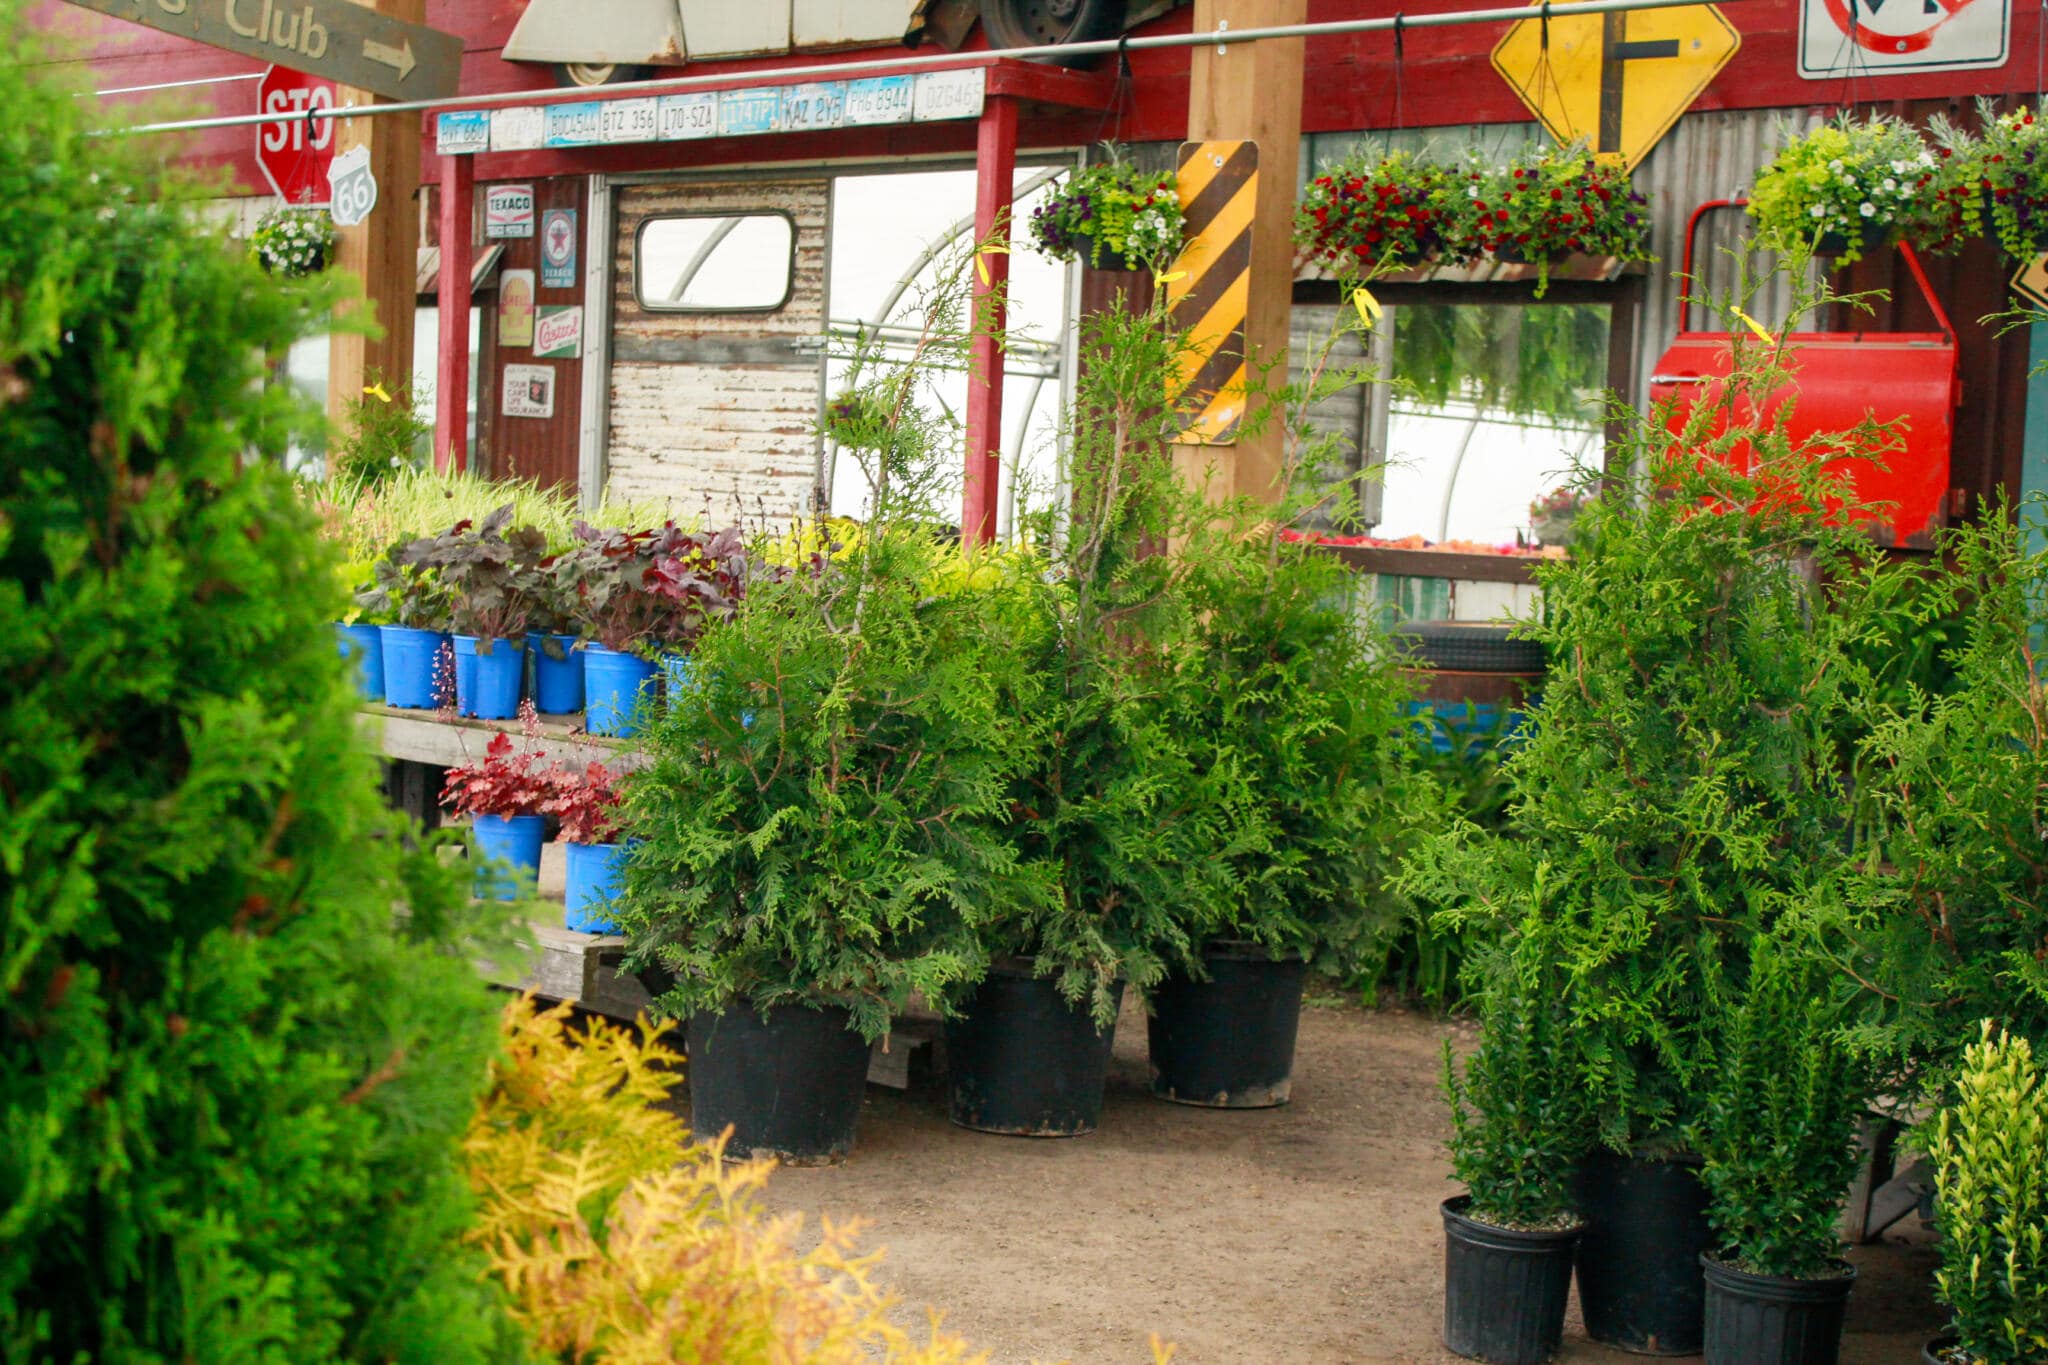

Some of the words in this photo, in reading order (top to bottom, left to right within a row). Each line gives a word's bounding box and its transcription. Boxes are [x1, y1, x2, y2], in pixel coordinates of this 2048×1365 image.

[225, 0, 329, 59] Club
[264, 86, 334, 152] STO
[602, 111, 624, 131] BTZ
[632, 109, 654, 129] 356
[664, 105, 712, 131] 170-SZA
[337, 173, 369, 217] 66
[490, 197, 530, 211] TEXACO
[538, 315, 578, 350] Castrol
